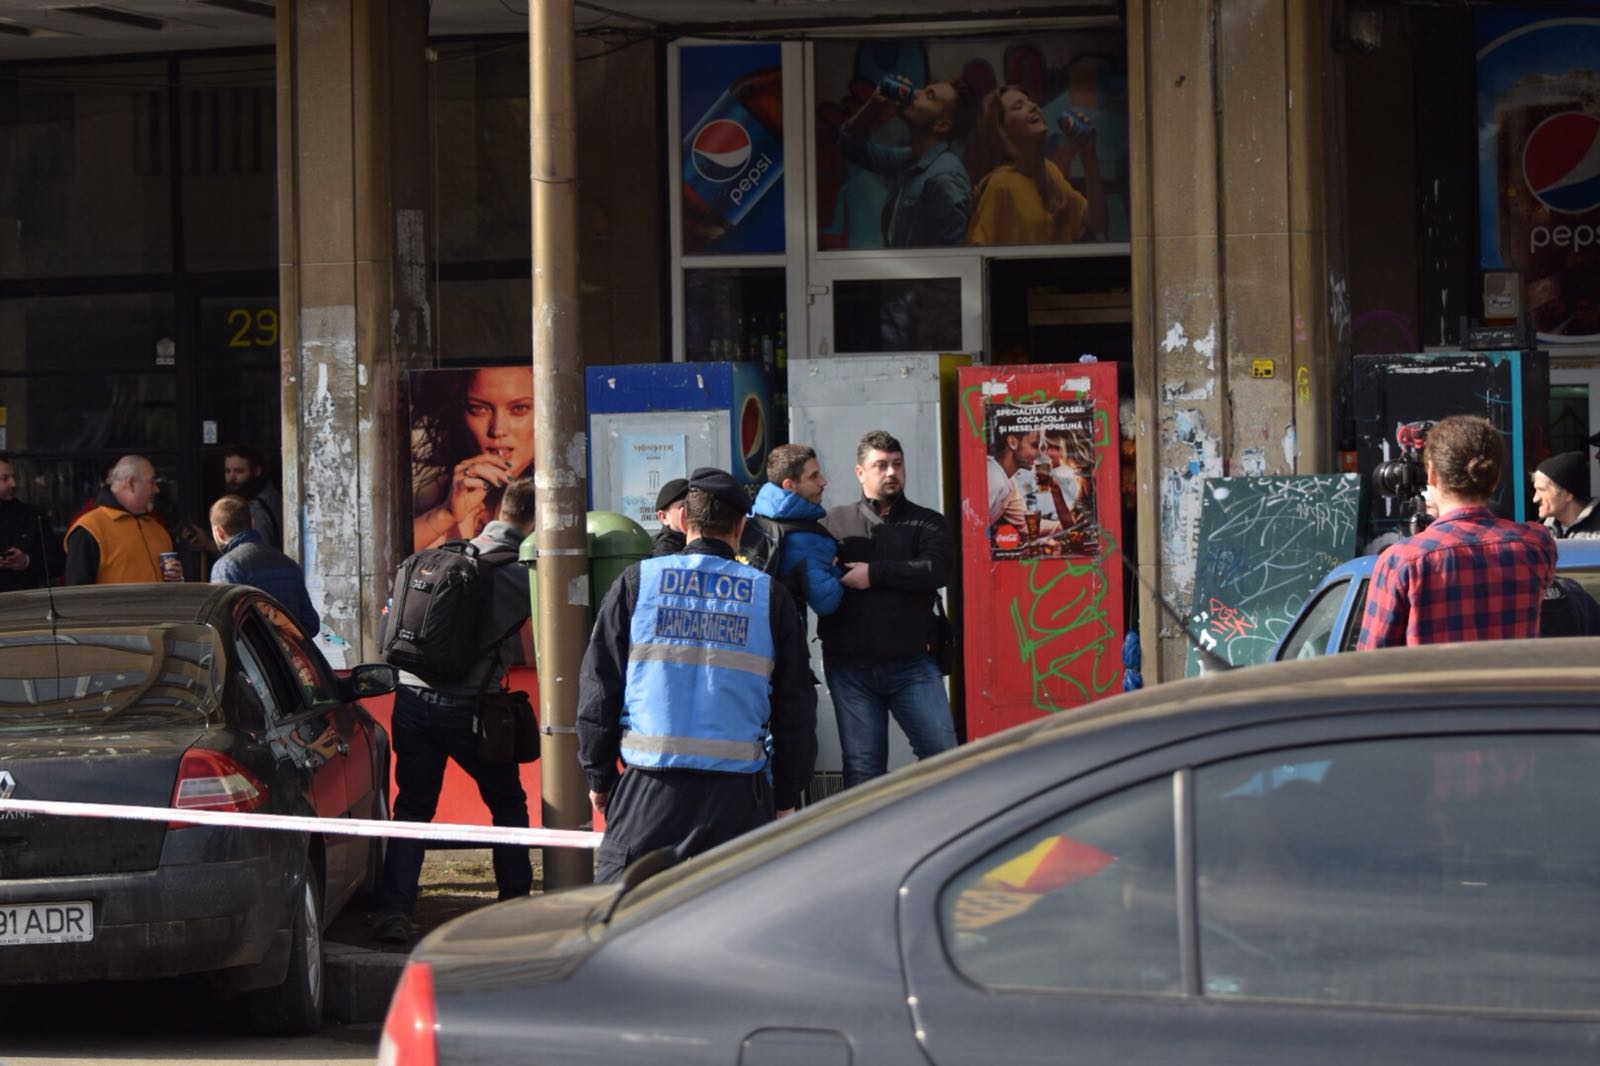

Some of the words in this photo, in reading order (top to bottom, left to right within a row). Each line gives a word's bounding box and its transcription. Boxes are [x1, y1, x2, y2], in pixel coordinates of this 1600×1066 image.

[730, 152, 773, 206] pepsi
[228, 309, 279, 346] 29
[996, 407, 1057, 416] SPECIALITATEA
[1017, 415, 1065, 424] COCA-COLA
[663, 570, 750, 601] DIALOG
[658, 608, 747, 646] JANDARMERIA
[24, 907, 83, 934] ADR
